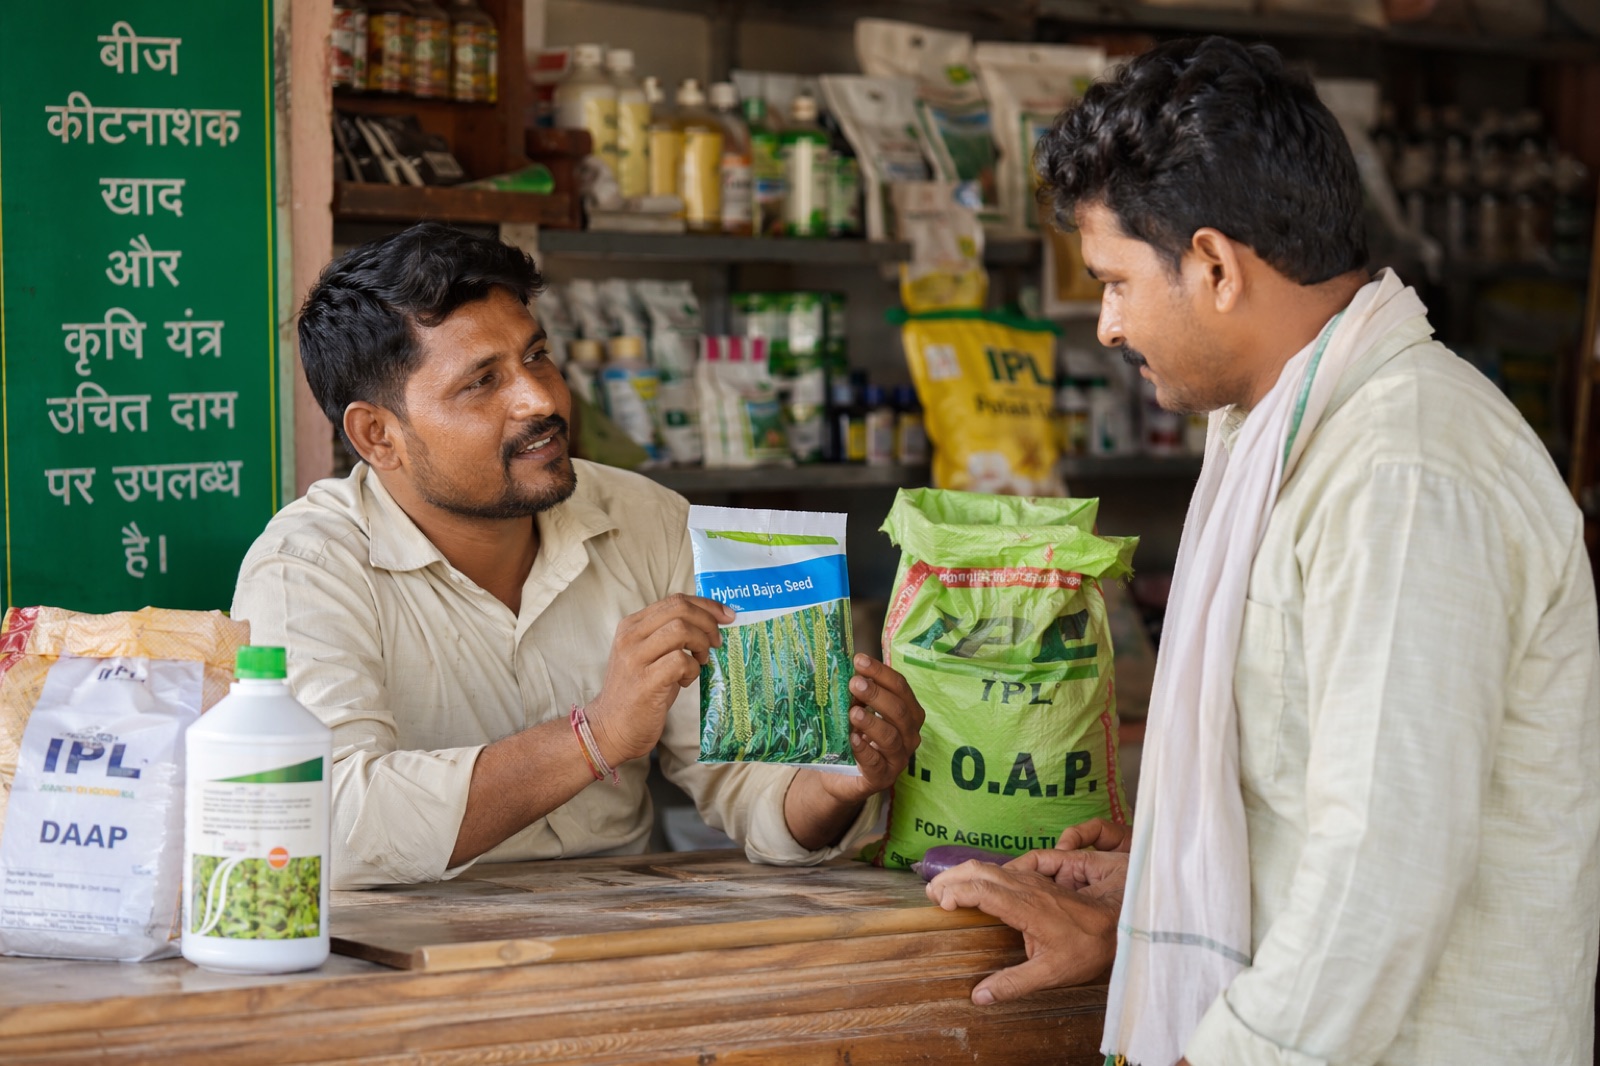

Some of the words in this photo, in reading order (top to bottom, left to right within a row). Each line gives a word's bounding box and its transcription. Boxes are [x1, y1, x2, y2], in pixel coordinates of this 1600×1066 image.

[98, 21, 182, 75] बीज
[45, 91, 241, 147] कीटनाशक
[99, 178, 185, 217] खाद
[105, 234, 182, 287] और
[62, 307, 147, 376] कृषि
[164, 308, 224, 358] यंत्र
[984, 347, 1054, 387] IPL
[46, 381, 151, 434] उचित
[168, 391, 238, 431] दाम
[45, 467, 96, 506] पर
[113, 461, 243, 502] उपलब्ध
[122, 521, 167, 578] है।
[711, 585, 750, 604] Hybrid
[752, 582, 783, 599] Bajra
[784, 576, 814, 593] Seed
[980, 678, 1054, 706] IPL
[43, 737, 141, 779] IPL
[39, 820, 128, 849] DAAP
[915, 817, 948, 840] FOR
